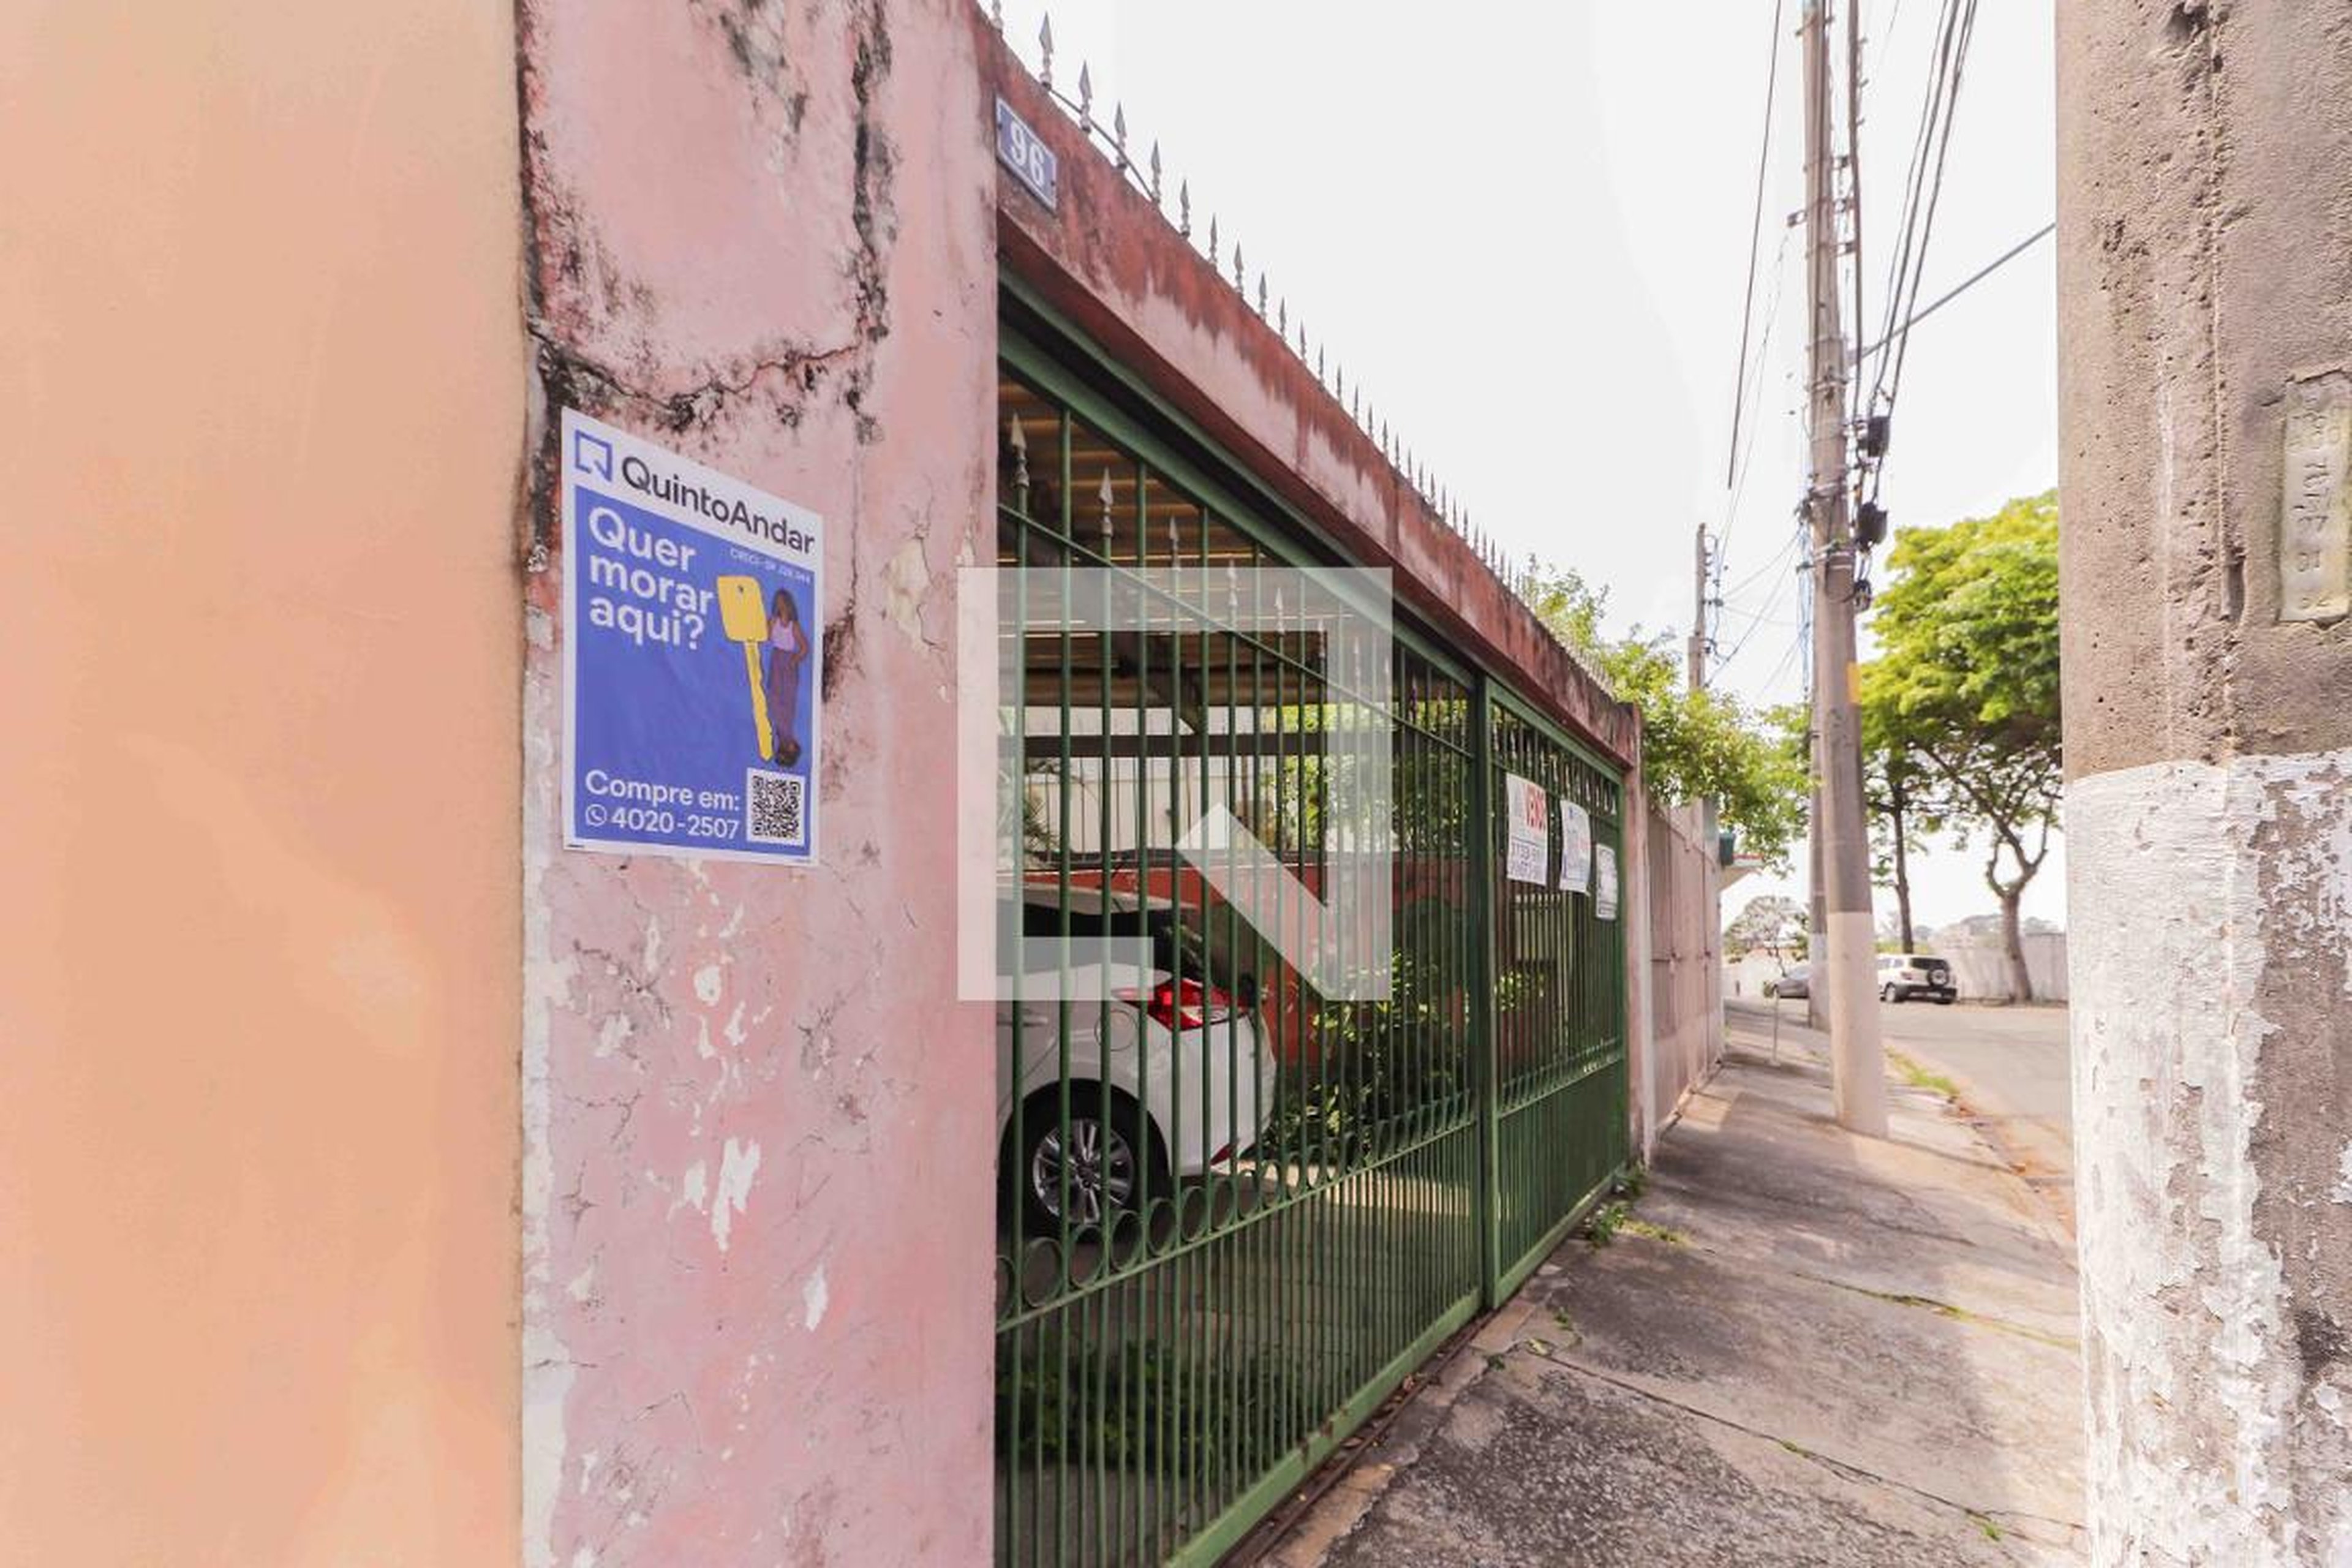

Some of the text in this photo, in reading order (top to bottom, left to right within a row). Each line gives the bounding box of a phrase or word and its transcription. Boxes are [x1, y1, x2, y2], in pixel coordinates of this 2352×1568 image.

[1011, 121, 1044, 186] 96
[622, 456, 815, 554] QuintoAndar
[589, 507, 696, 572] Quer
[590, 554, 714, 615] morar
[590, 597, 704, 650] aqui?
[586, 769, 740, 812] Compre em:
[612, 807, 741, 840] 4020-2507
